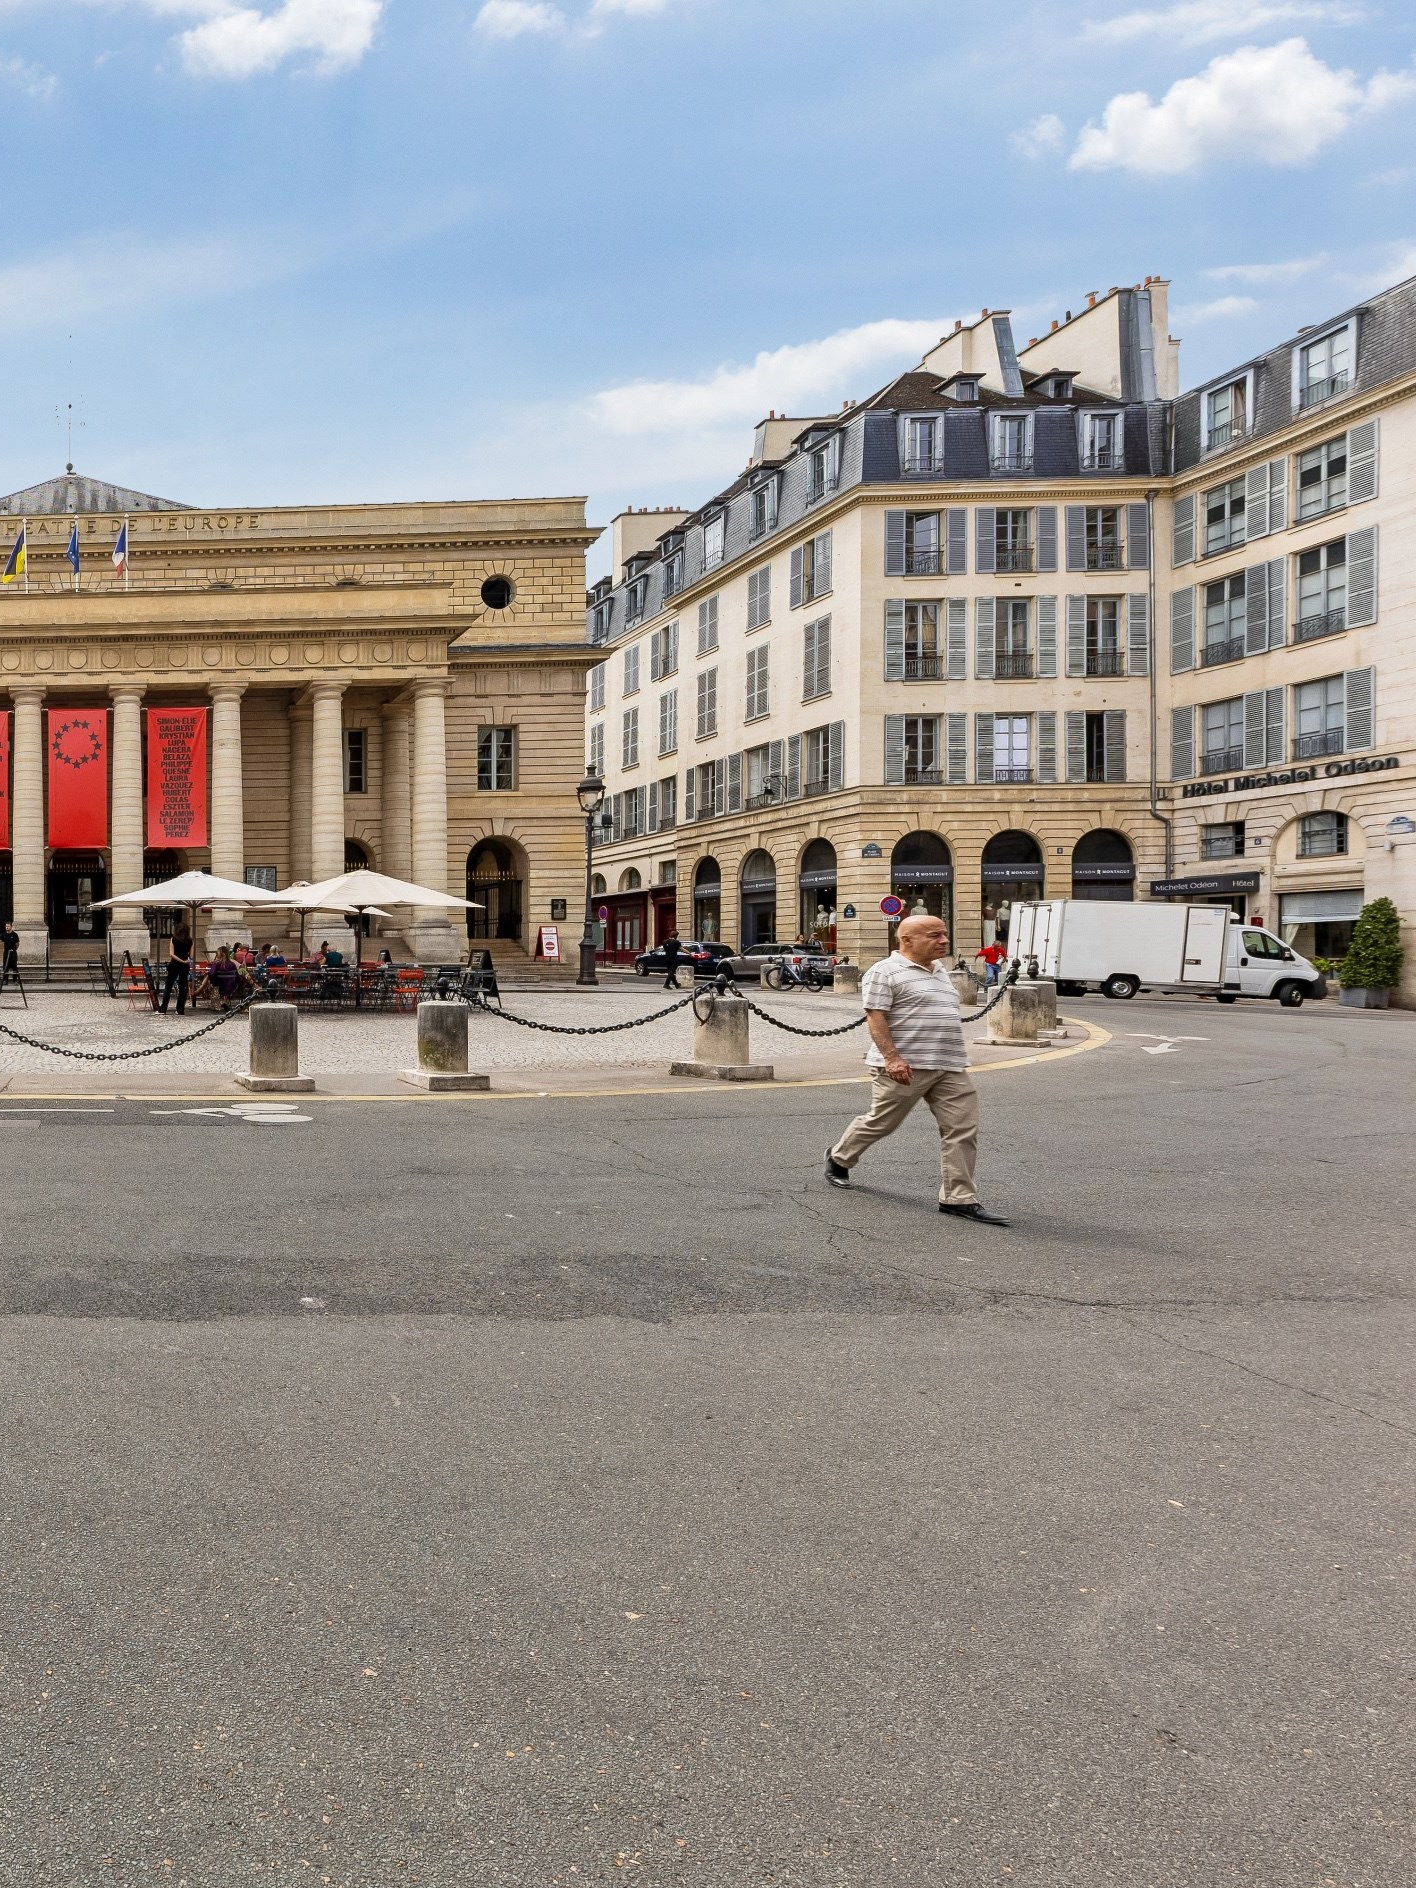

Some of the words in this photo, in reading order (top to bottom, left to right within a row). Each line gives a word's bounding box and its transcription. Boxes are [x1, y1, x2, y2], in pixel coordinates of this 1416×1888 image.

[110, 519, 138, 533] DE
[151, 515, 259, 532] L'EUROPE
[1183, 780, 1229, 798] Hôtel
[1234, 766, 1316, 792] Michelet
[1325, 757, 1400, 777] Odéon
[1155, 883, 1188, 892] Michelet
[1190, 881, 1218, 889] Odéon
